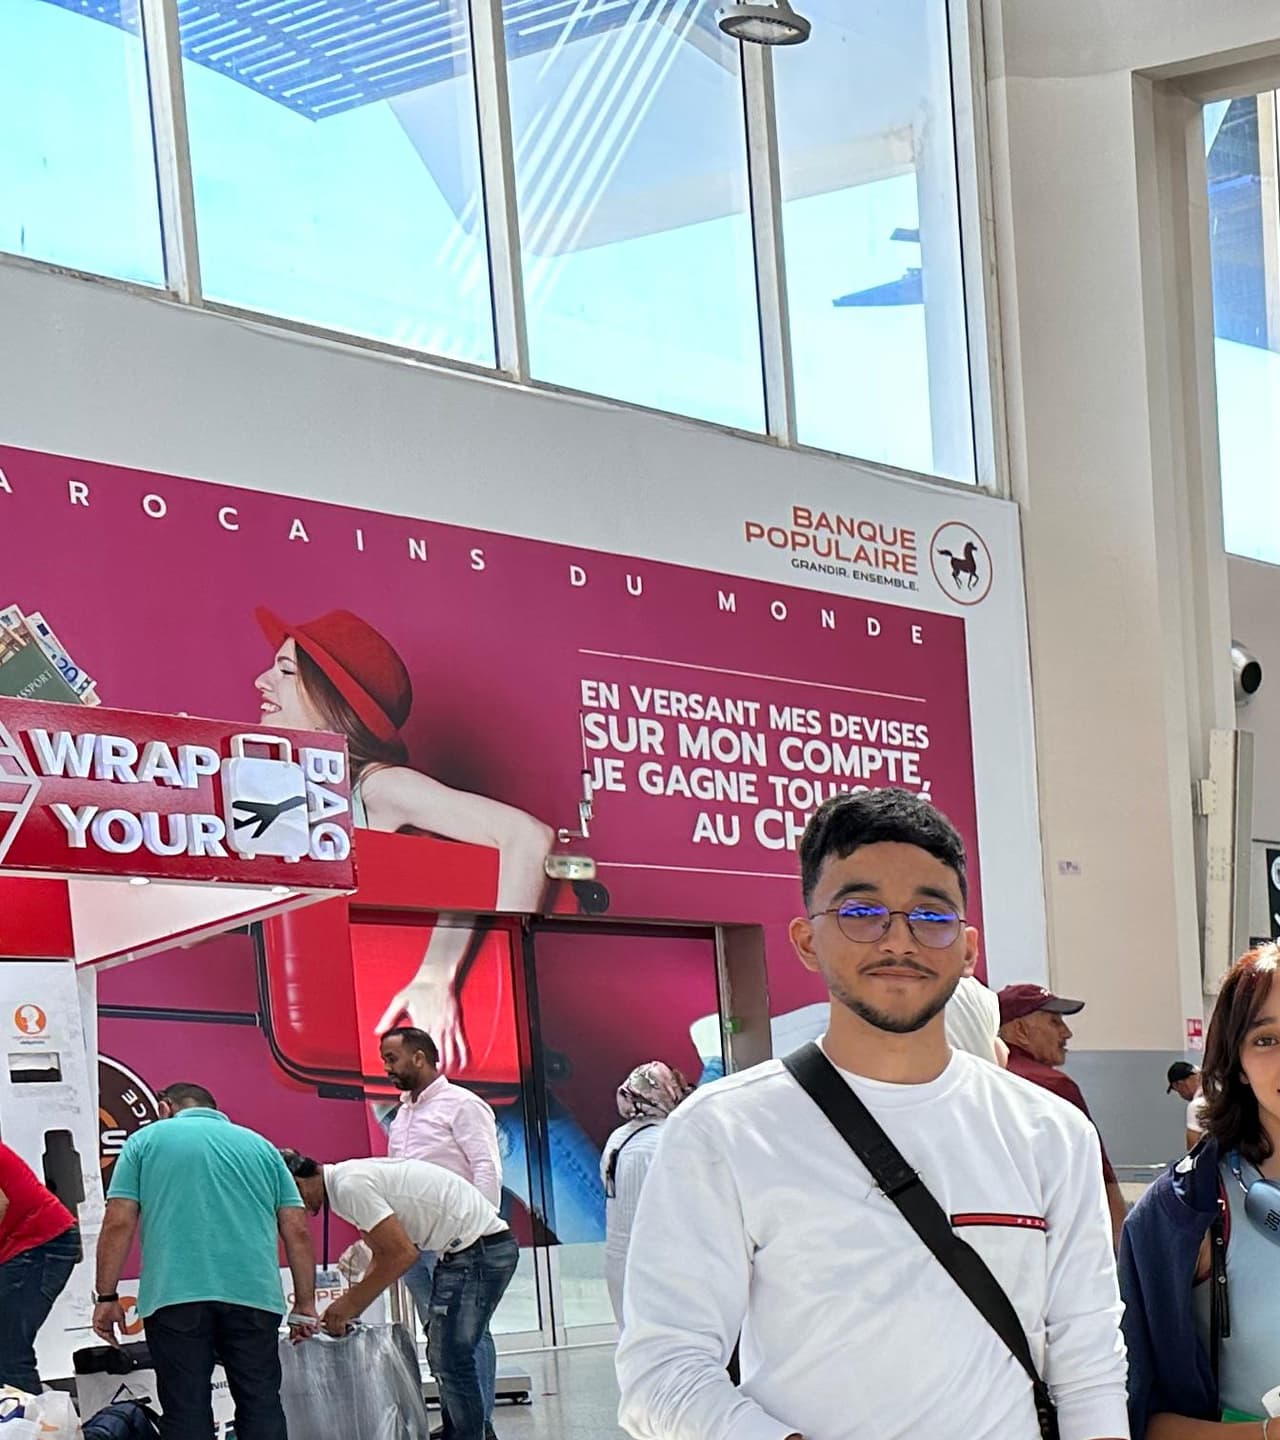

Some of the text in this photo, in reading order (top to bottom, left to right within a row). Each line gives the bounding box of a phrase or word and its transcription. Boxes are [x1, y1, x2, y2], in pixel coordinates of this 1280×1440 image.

[744, 521, 919, 576] POPULAIRE
[792, 505, 917, 551] BANQUE
[791, 558, 920, 592] GRANDIR. ENSEMBLE.
[570, 565, 643, 596] DU
[717, 590, 923, 645] MONDE
[581, 680, 930, 750] EN VERSANT MES DEVISES
[29, 728, 221, 789] WRAP
[584, 713, 931, 787] SUR MON COMPTE,
[298, 747, 351, 861] BAG
[591, 758, 626, 793] JE
[638, 763, 759, 805] GAGNE
[50, 803, 229, 858] YOUR
[693, 813, 740, 846] AU
